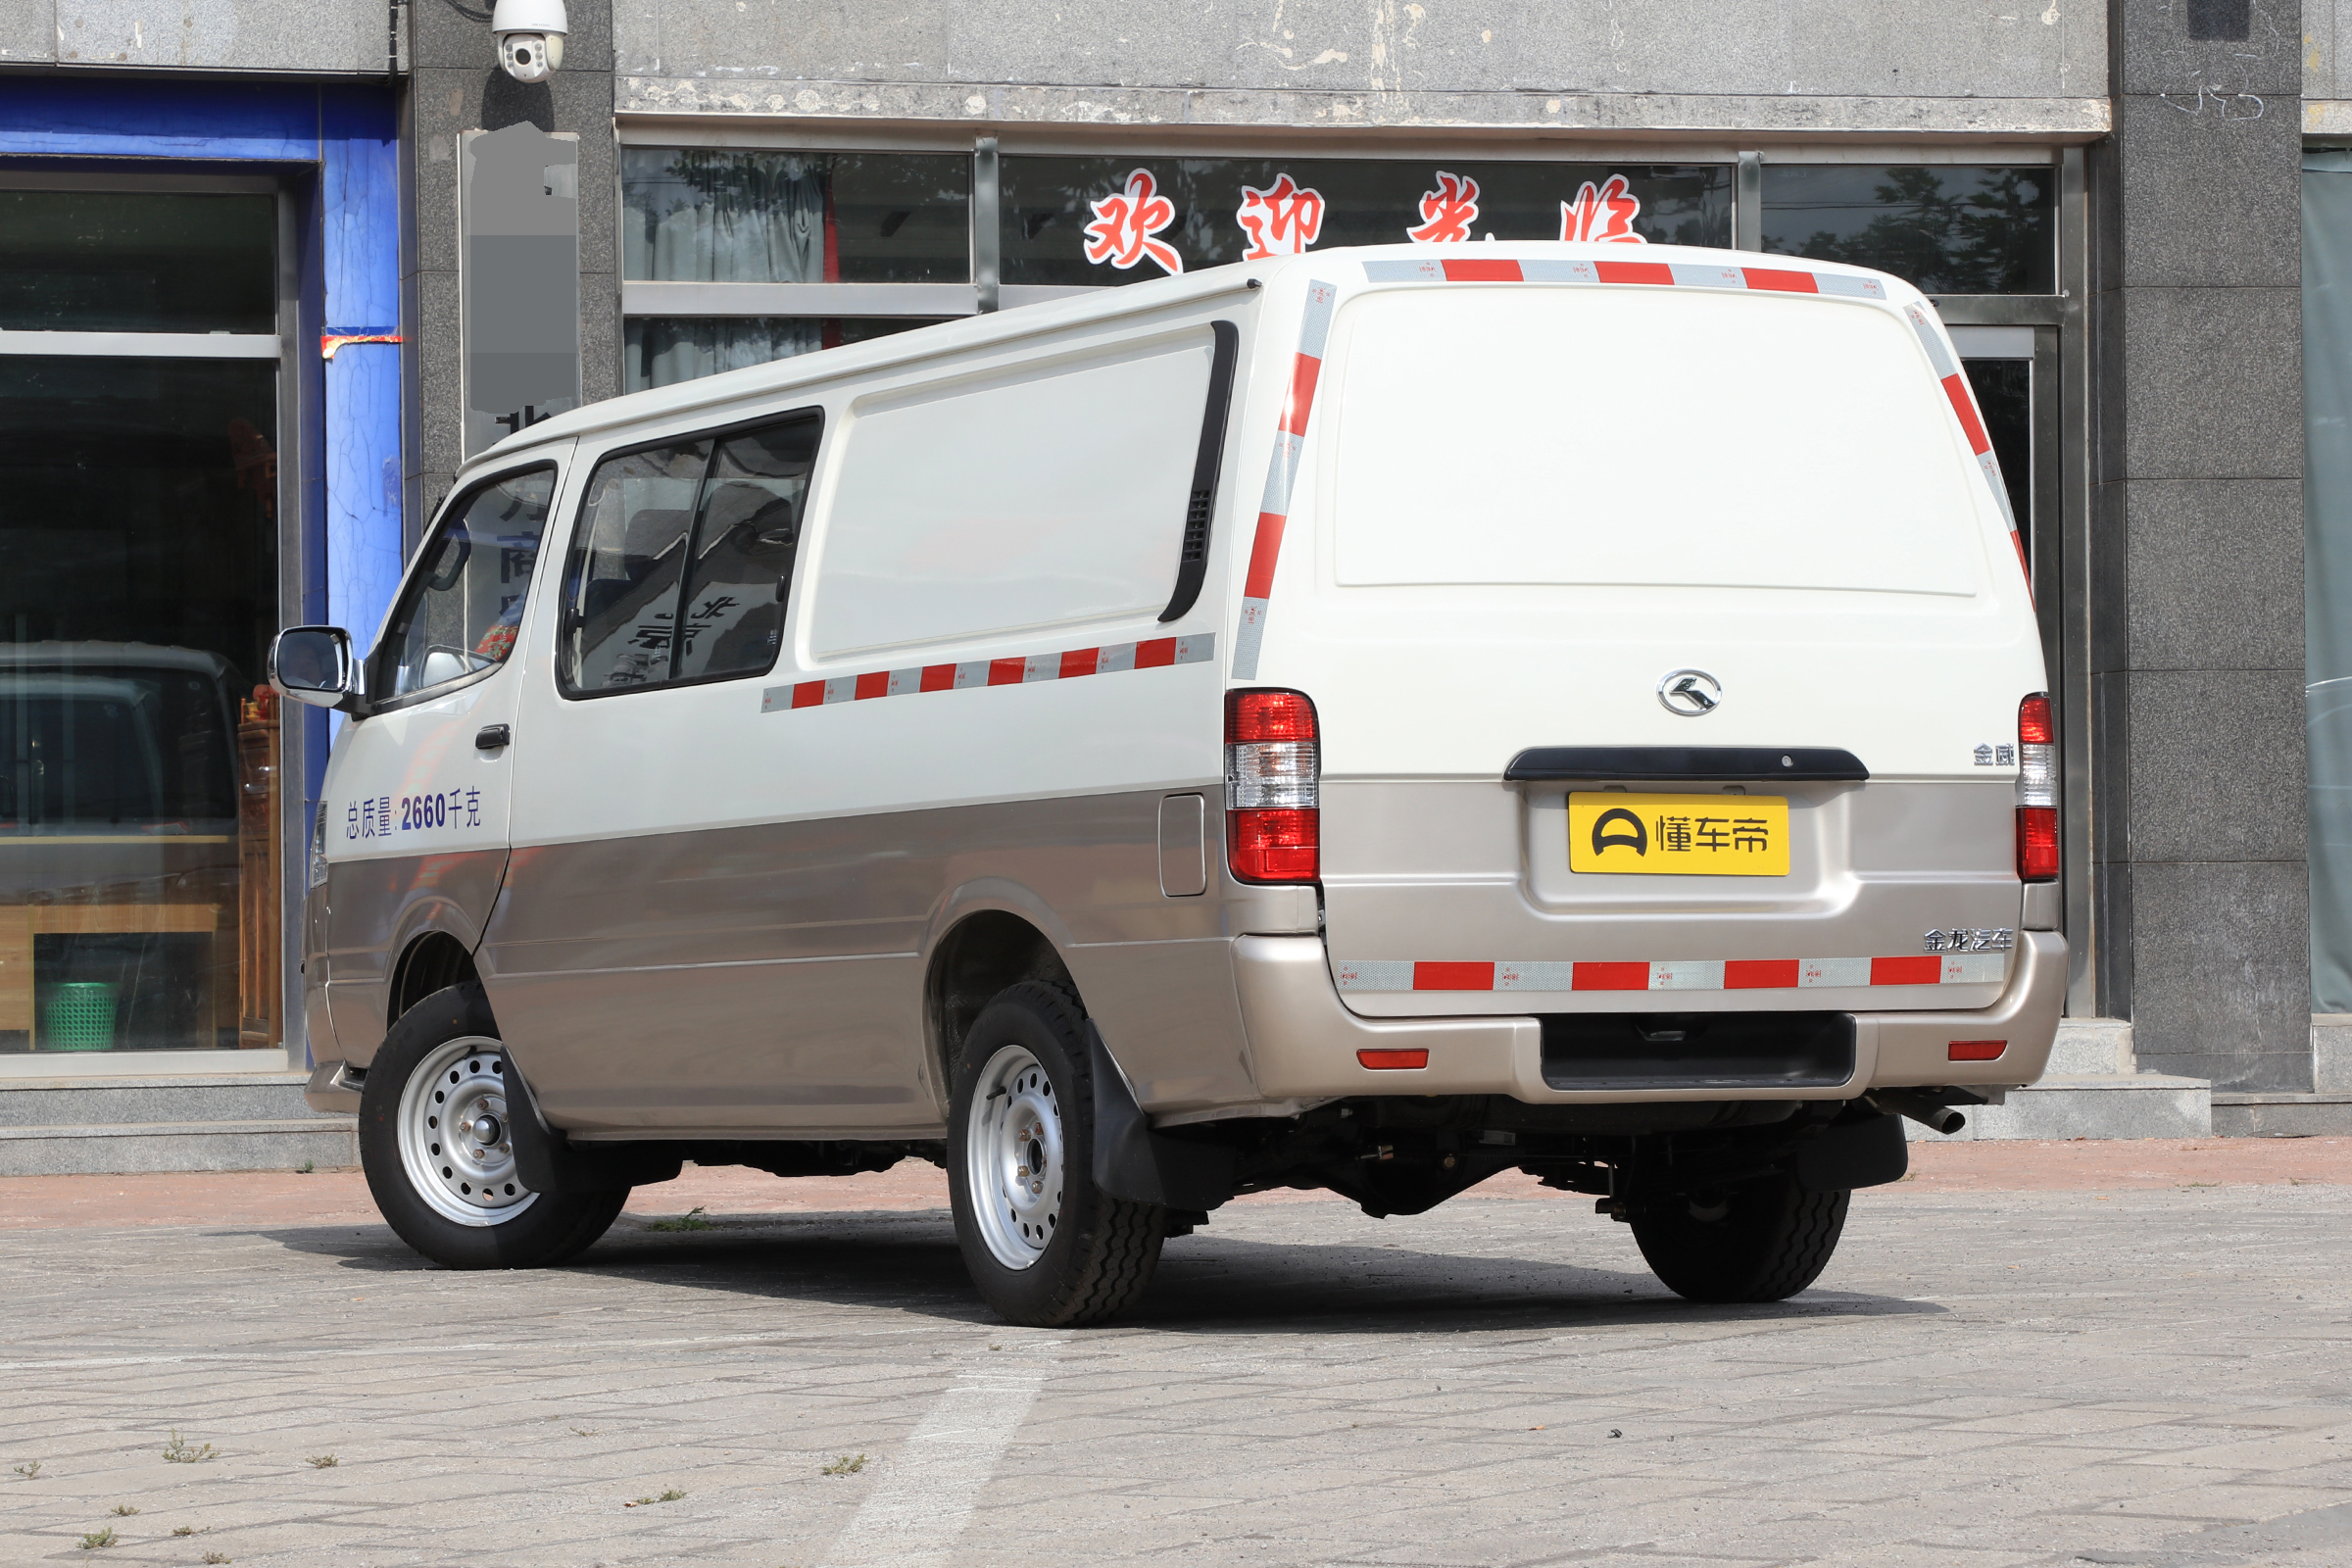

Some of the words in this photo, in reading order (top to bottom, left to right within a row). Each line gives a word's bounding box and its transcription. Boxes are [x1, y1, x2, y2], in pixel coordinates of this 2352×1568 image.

[1082, 168, 1648, 274] 欢迎光临
[1973, 742, 2015, 766] 金威
[1656, 814, 1769, 853] 懂车帝
[1924, 927, 2013, 953] 金龙汽车
